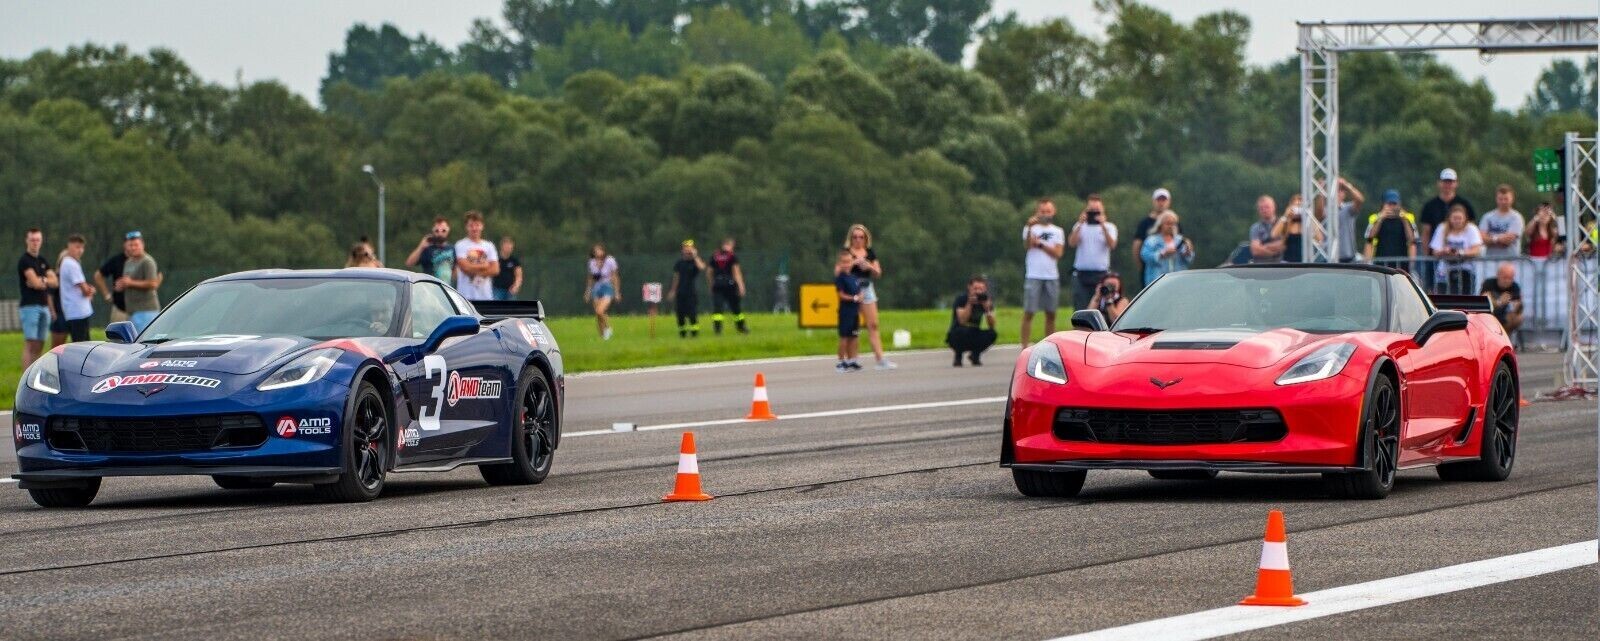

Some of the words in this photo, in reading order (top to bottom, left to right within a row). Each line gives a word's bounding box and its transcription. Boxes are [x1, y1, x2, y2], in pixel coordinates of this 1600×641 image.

[419, 355, 447, 430] 3
[299, 418, 330, 427] AMD
[22, 424, 40, 432] AMD
